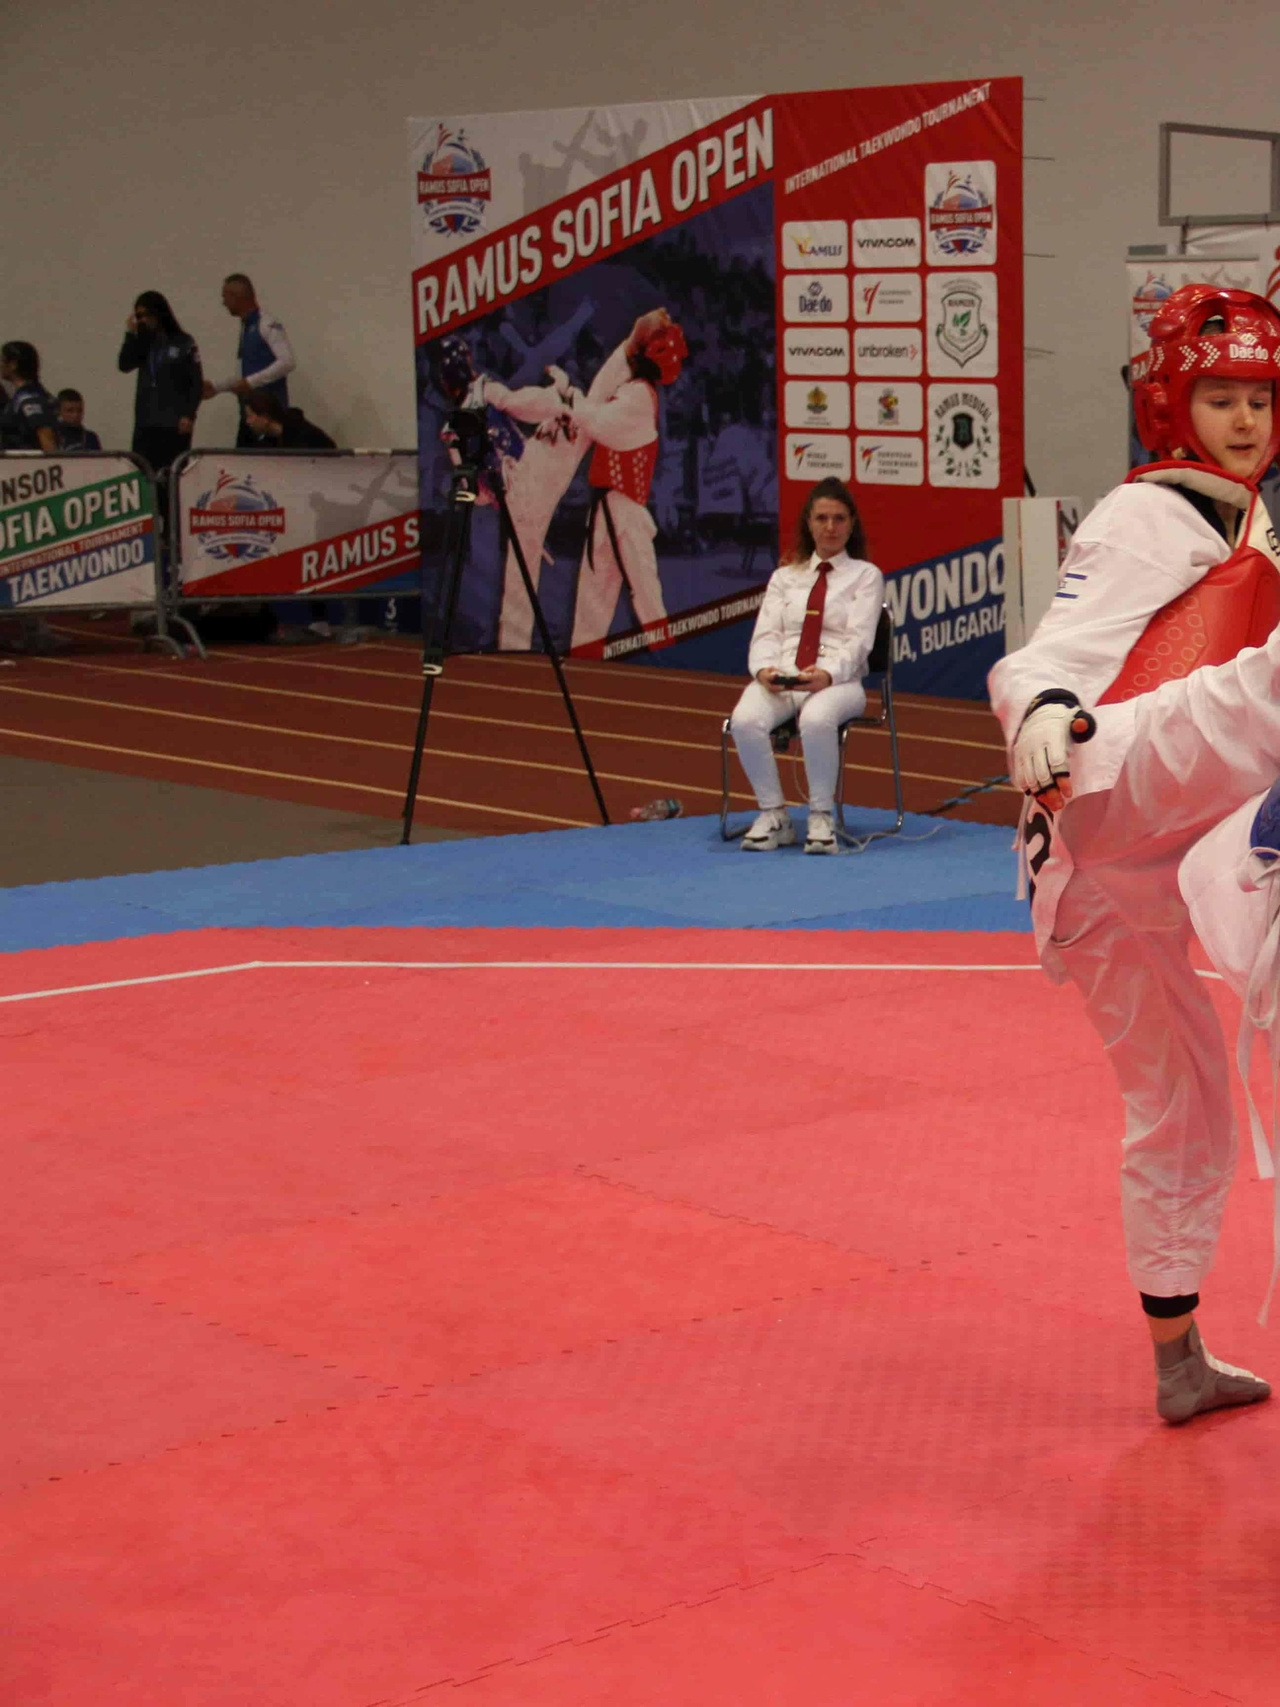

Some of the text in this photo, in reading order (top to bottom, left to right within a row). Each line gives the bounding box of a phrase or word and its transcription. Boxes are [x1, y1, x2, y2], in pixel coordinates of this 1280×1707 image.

[416, 108, 774, 335] RAMUS SOFIA OPEN
[857, 238, 917, 248] VIVACOM
[788, 347, 845, 357] VIVACOM
[1229, 344, 1269, 360] Daedo
[63, 478, 142, 531] OPEN
[192, 515, 283, 527] RAMUS SOFIA OPEN
[301, 524, 398, 583] RAMUS
[7, 538, 145, 602] TAEKWONDO
[667, 608, 720, 638] TAEKWONDO
